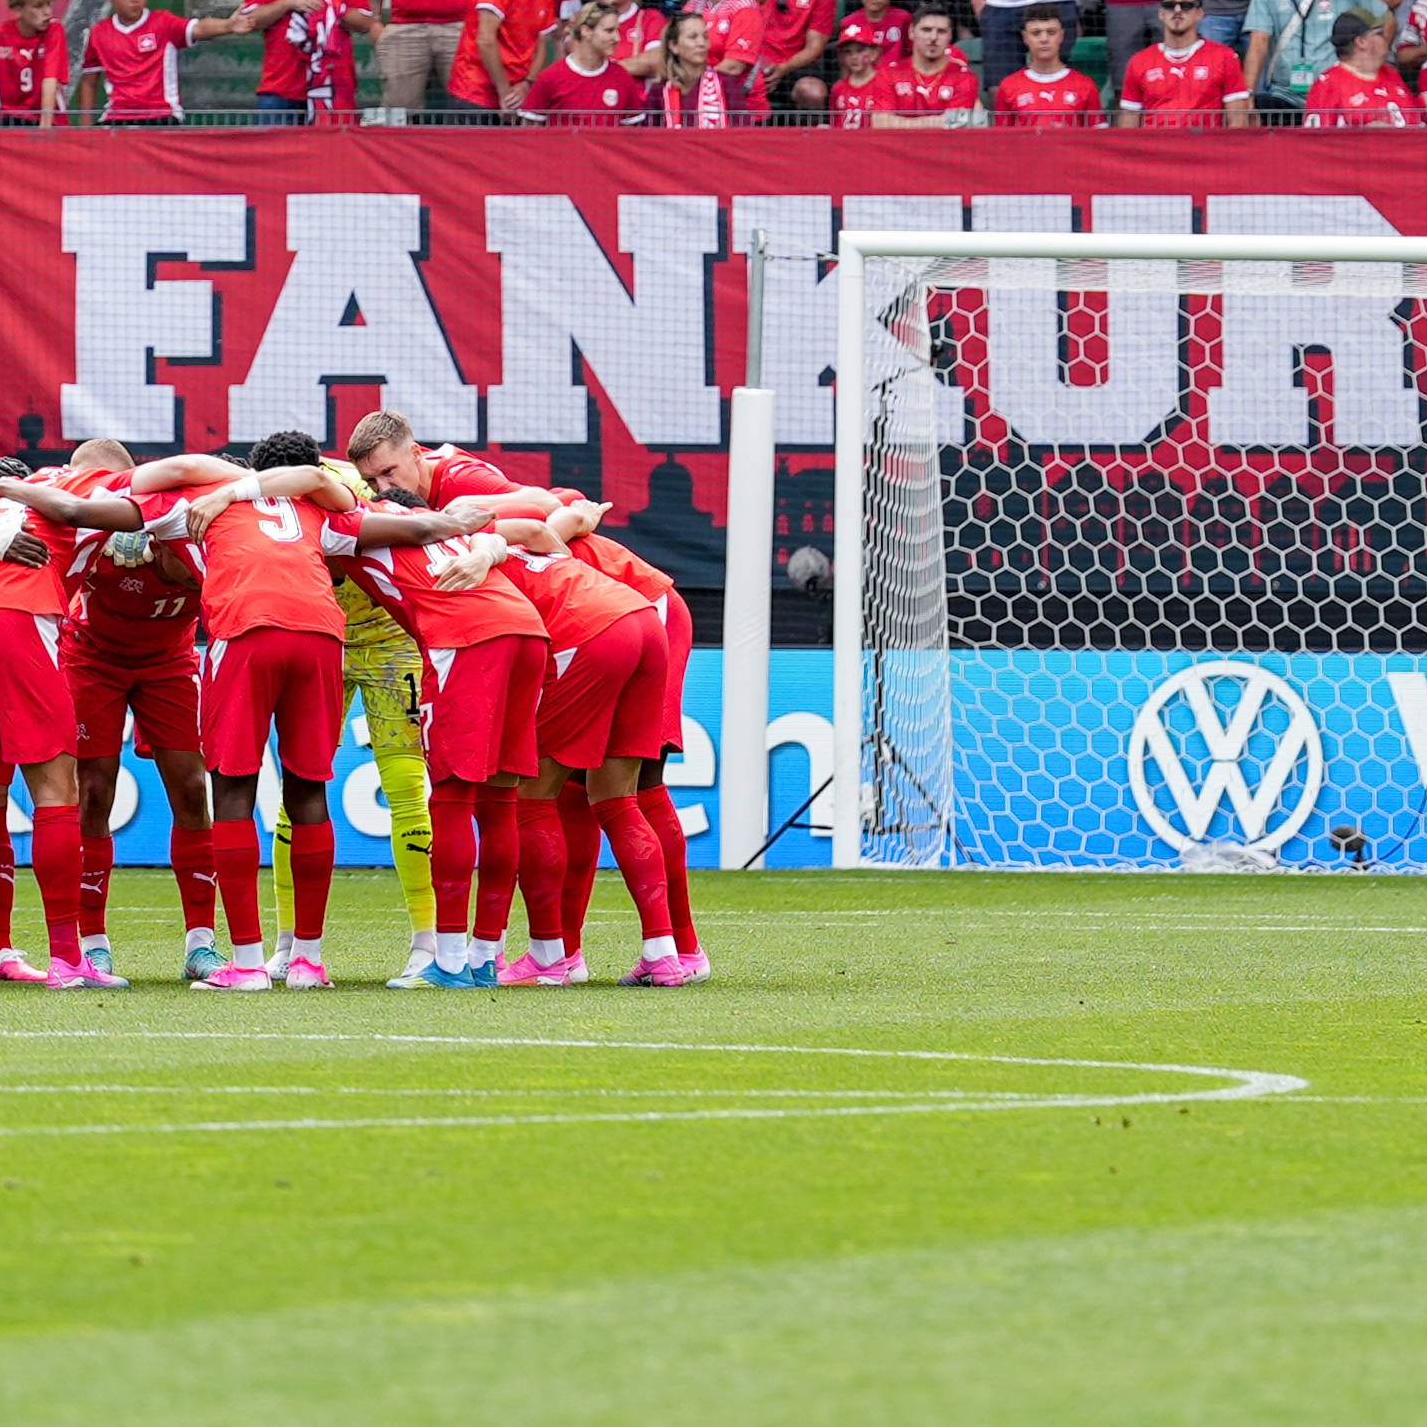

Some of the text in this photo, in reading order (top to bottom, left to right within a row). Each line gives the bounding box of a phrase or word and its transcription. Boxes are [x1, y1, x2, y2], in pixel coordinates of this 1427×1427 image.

[19, 69, 33, 93] 9
[252, 494, 304, 542] 9
[149, 596, 187, 619] 11
[403, 672, 421, 716] 1
